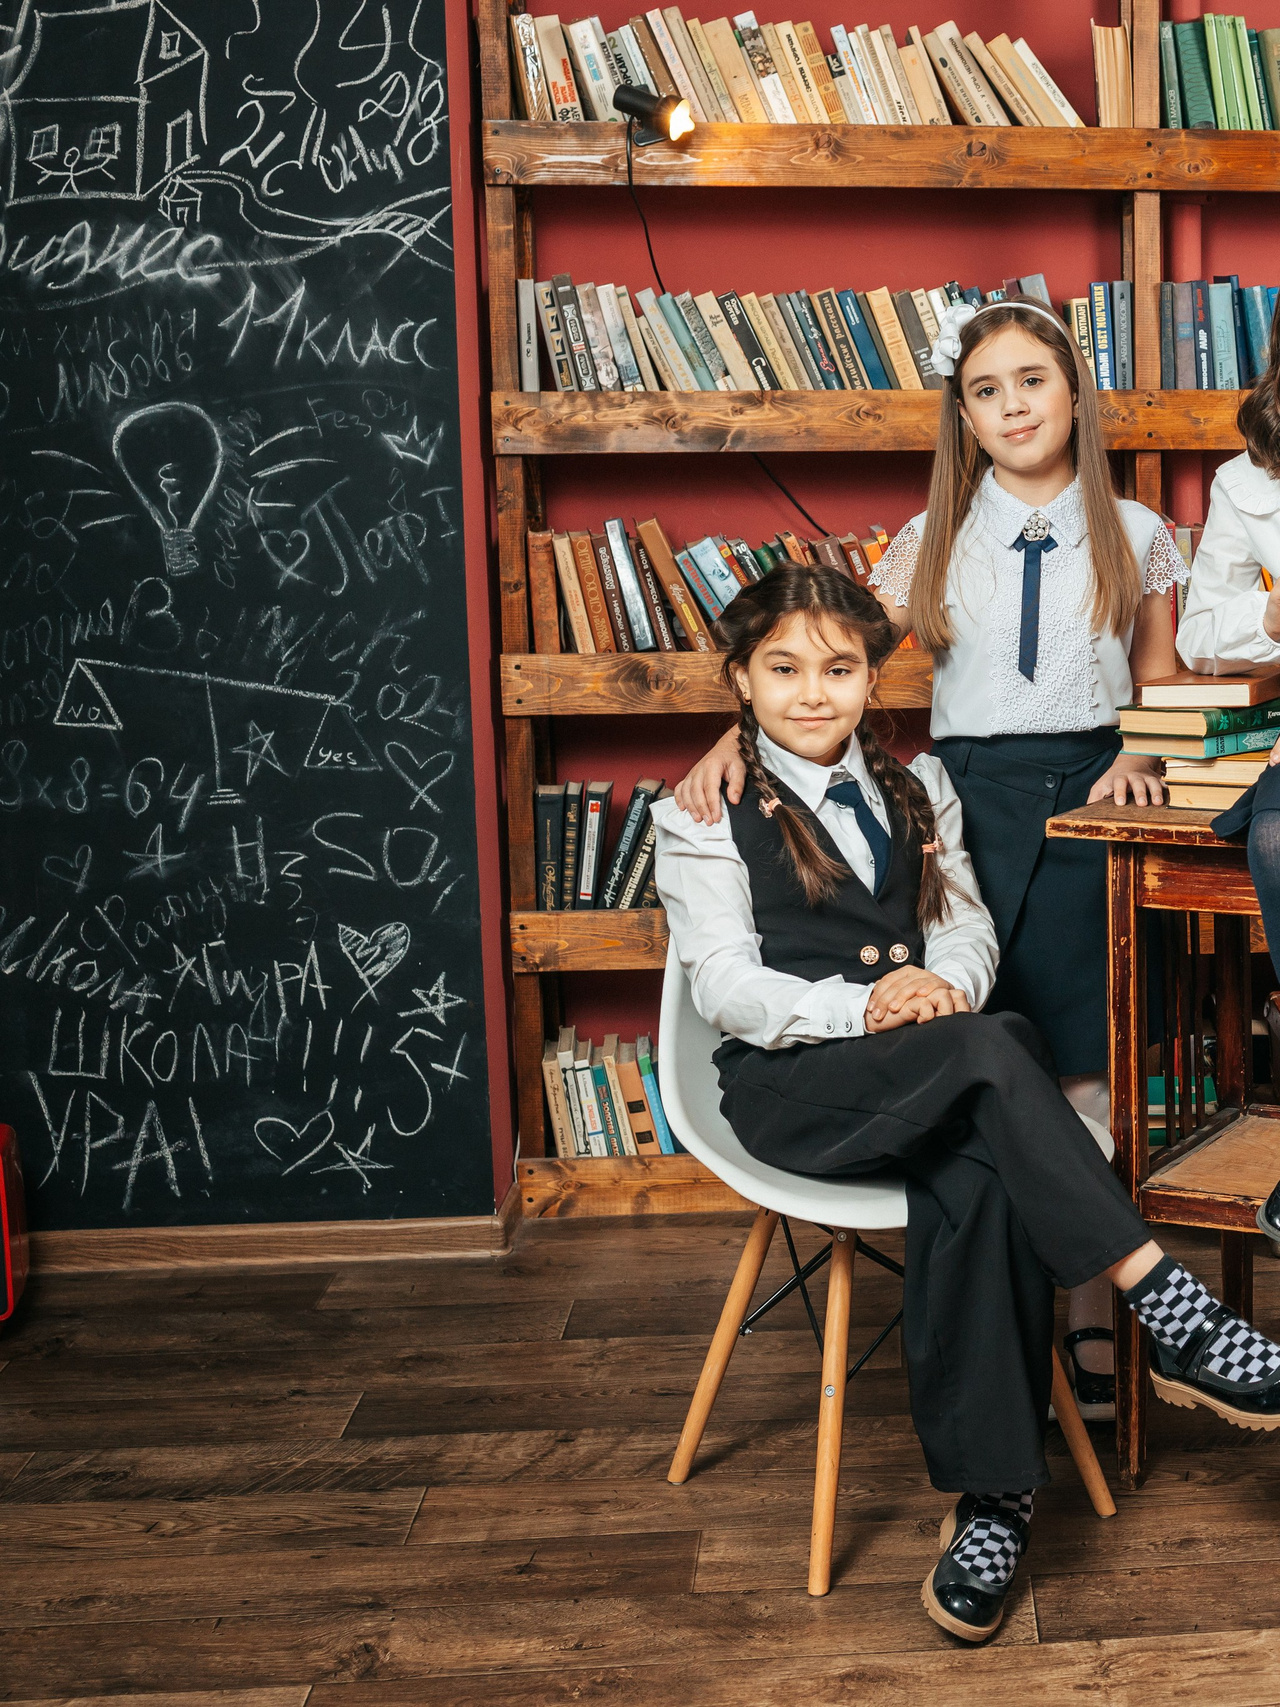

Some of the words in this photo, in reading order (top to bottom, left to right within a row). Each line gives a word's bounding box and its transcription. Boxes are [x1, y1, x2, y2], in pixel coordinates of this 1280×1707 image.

[969, 74, 984, 93] ГОРЫ
[1168, 88, 1177, 118] МАНОВ
[722, 299, 740, 326] СЕРГЕЕВ
[819, 294, 845, 340] рассказы
[1074, 304, 1091, 337] ЛОТМАН
[1091, 284, 1108, 328] МОЛЧАНИЯ
[296, 316, 448, 370] КЛАСС
[1095, 328, 1109, 349] ОБЕТ
[1197, 328, 1208, 350] МИР
[1097, 351, 1110, 377] ИЛЬИН
[573, 537, 594, 571] ДЕЛО
[596, 545, 617, 591] Мастера
[636, 547, 649, 570] ВОИН
[582, 571, 604, 615] СЛОВО
[643, 570, 659, 604] РОЗЫСКА
[681, 556, 715, 606] ОПЕРАЦИЯ
[652, 604, 673, 650] УГОЛОВНОГО
[67, 703, 102, 722] NO
[318, 746, 359, 766] yes
[585, 1103, 597, 1131] ENGLISH
[600, 1100, 615, 1135] ЗОЛОТАЯ
